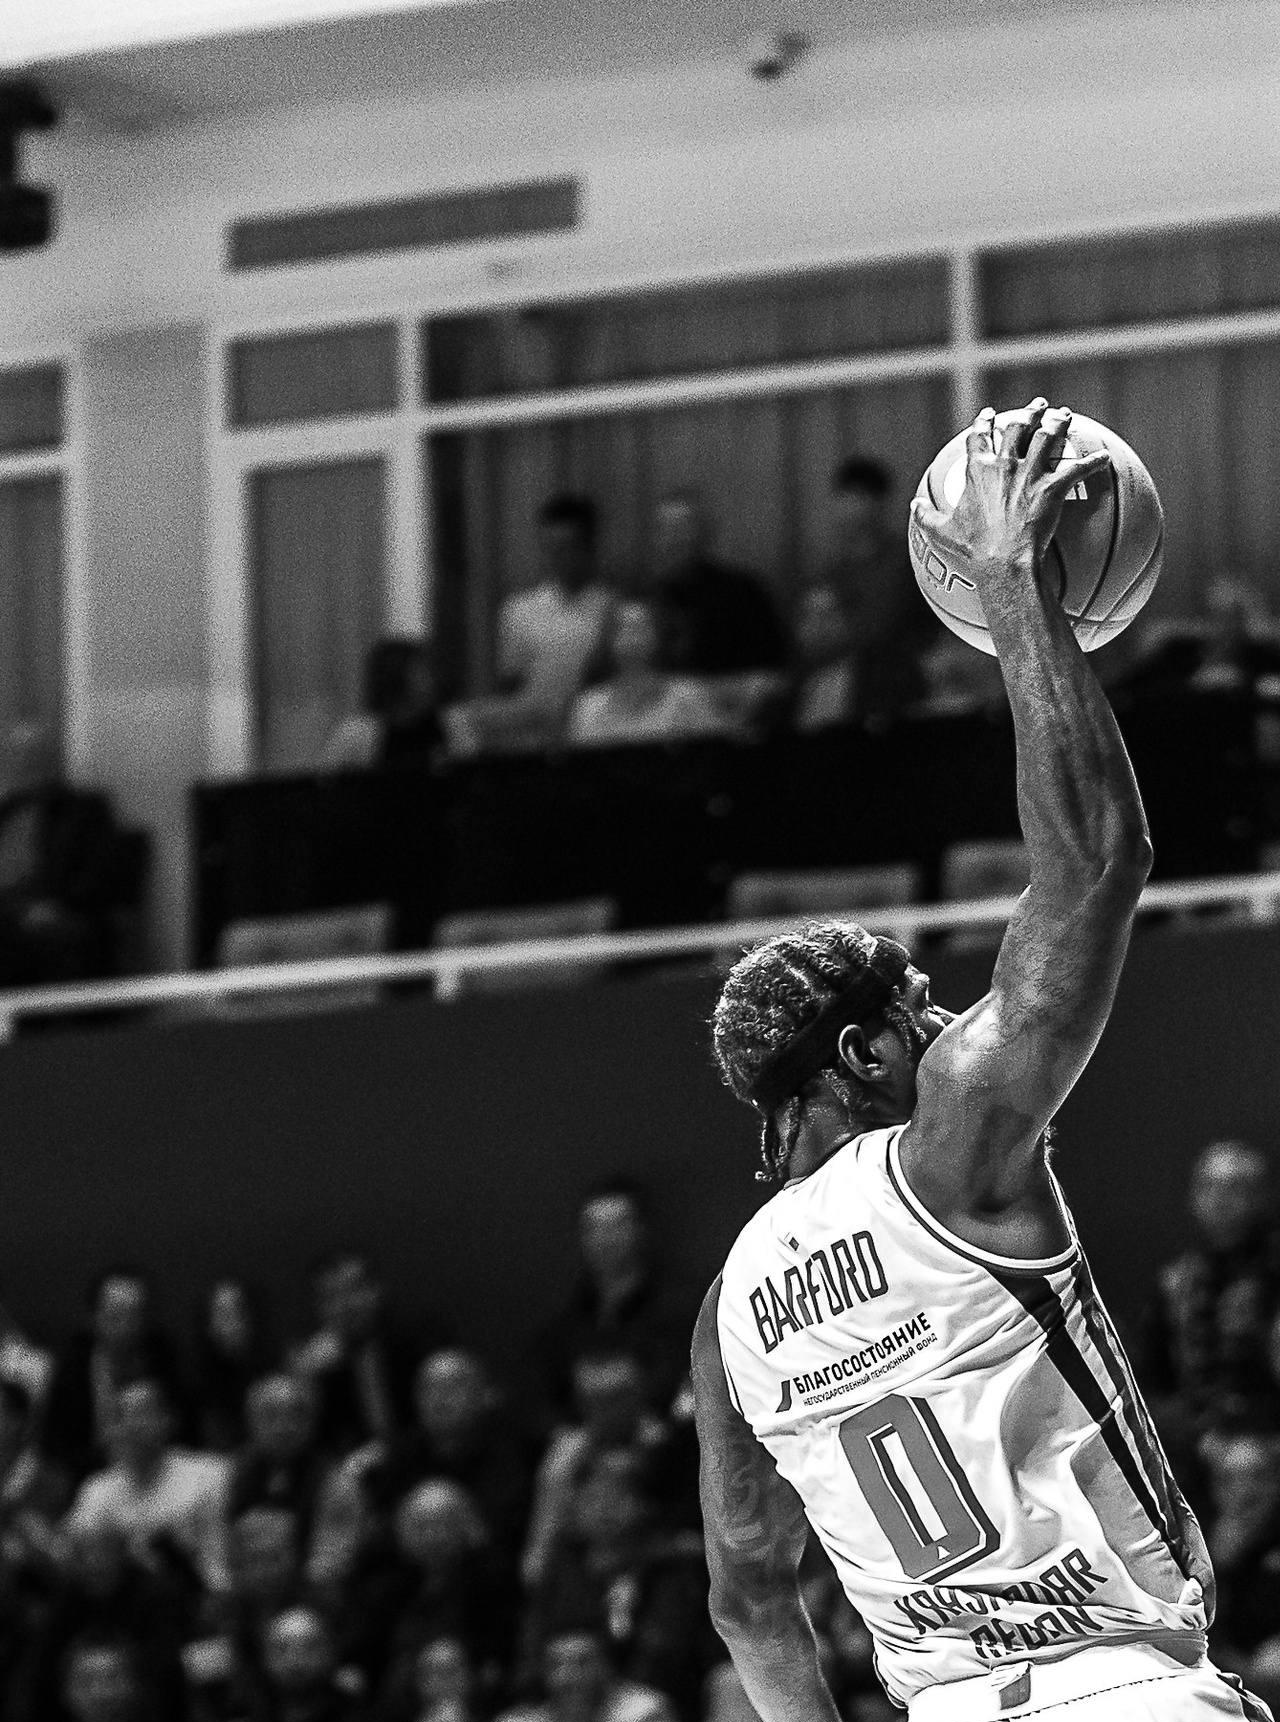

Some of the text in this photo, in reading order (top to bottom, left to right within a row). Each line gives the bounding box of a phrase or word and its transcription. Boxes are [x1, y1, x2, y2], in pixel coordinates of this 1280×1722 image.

[749, 1230, 889, 1354] BARFORD
[793, 1312, 931, 1394] БЛАГОСОСТОЯНИЕ
[803, 1333, 938, 1406] НЕГОСУДАРСТВЕННЫЙ ПЕНСИОННЫЙ ФОНД
[838, 1393, 1001, 1585] 0
